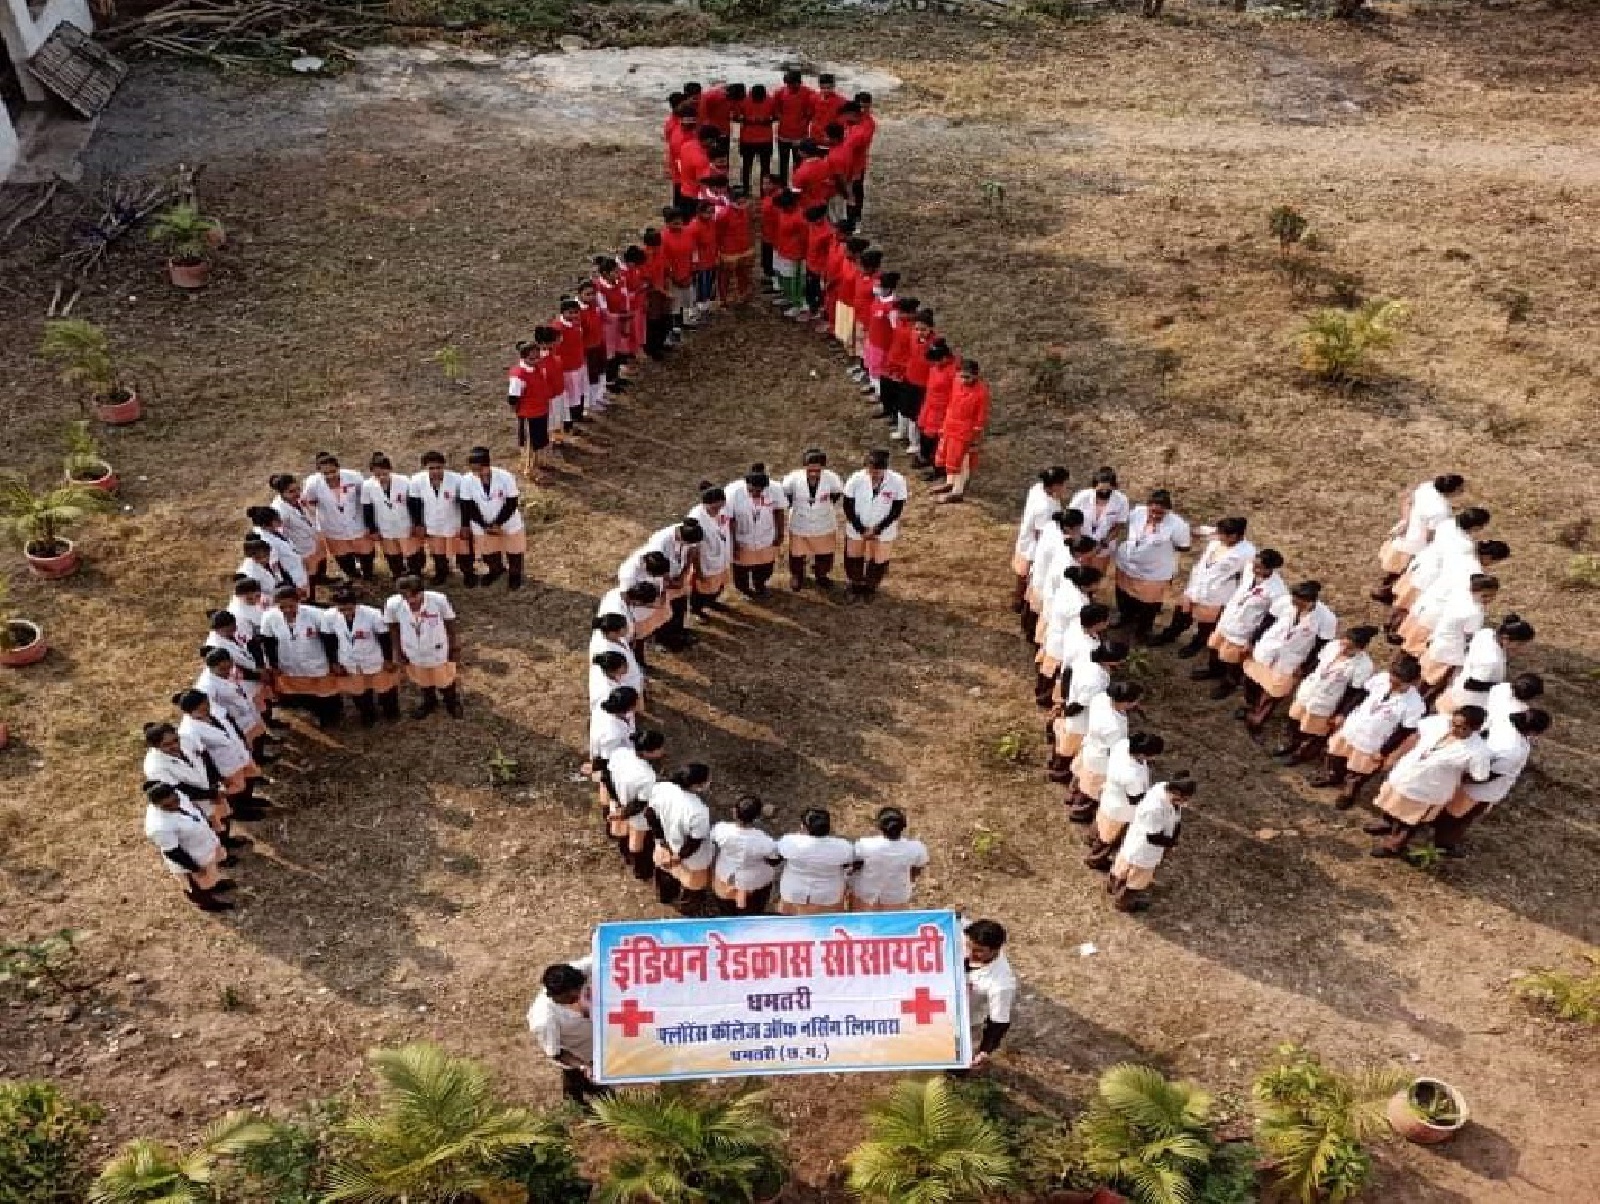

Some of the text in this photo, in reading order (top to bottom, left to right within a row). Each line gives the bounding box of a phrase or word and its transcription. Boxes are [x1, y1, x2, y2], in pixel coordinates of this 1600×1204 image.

[611, 926, 944, 991] इंडियन रेडक्रास सोसायटी
[747, 986, 812, 1011] धमतरी
[730, 1045, 775, 1061] धमतरी
